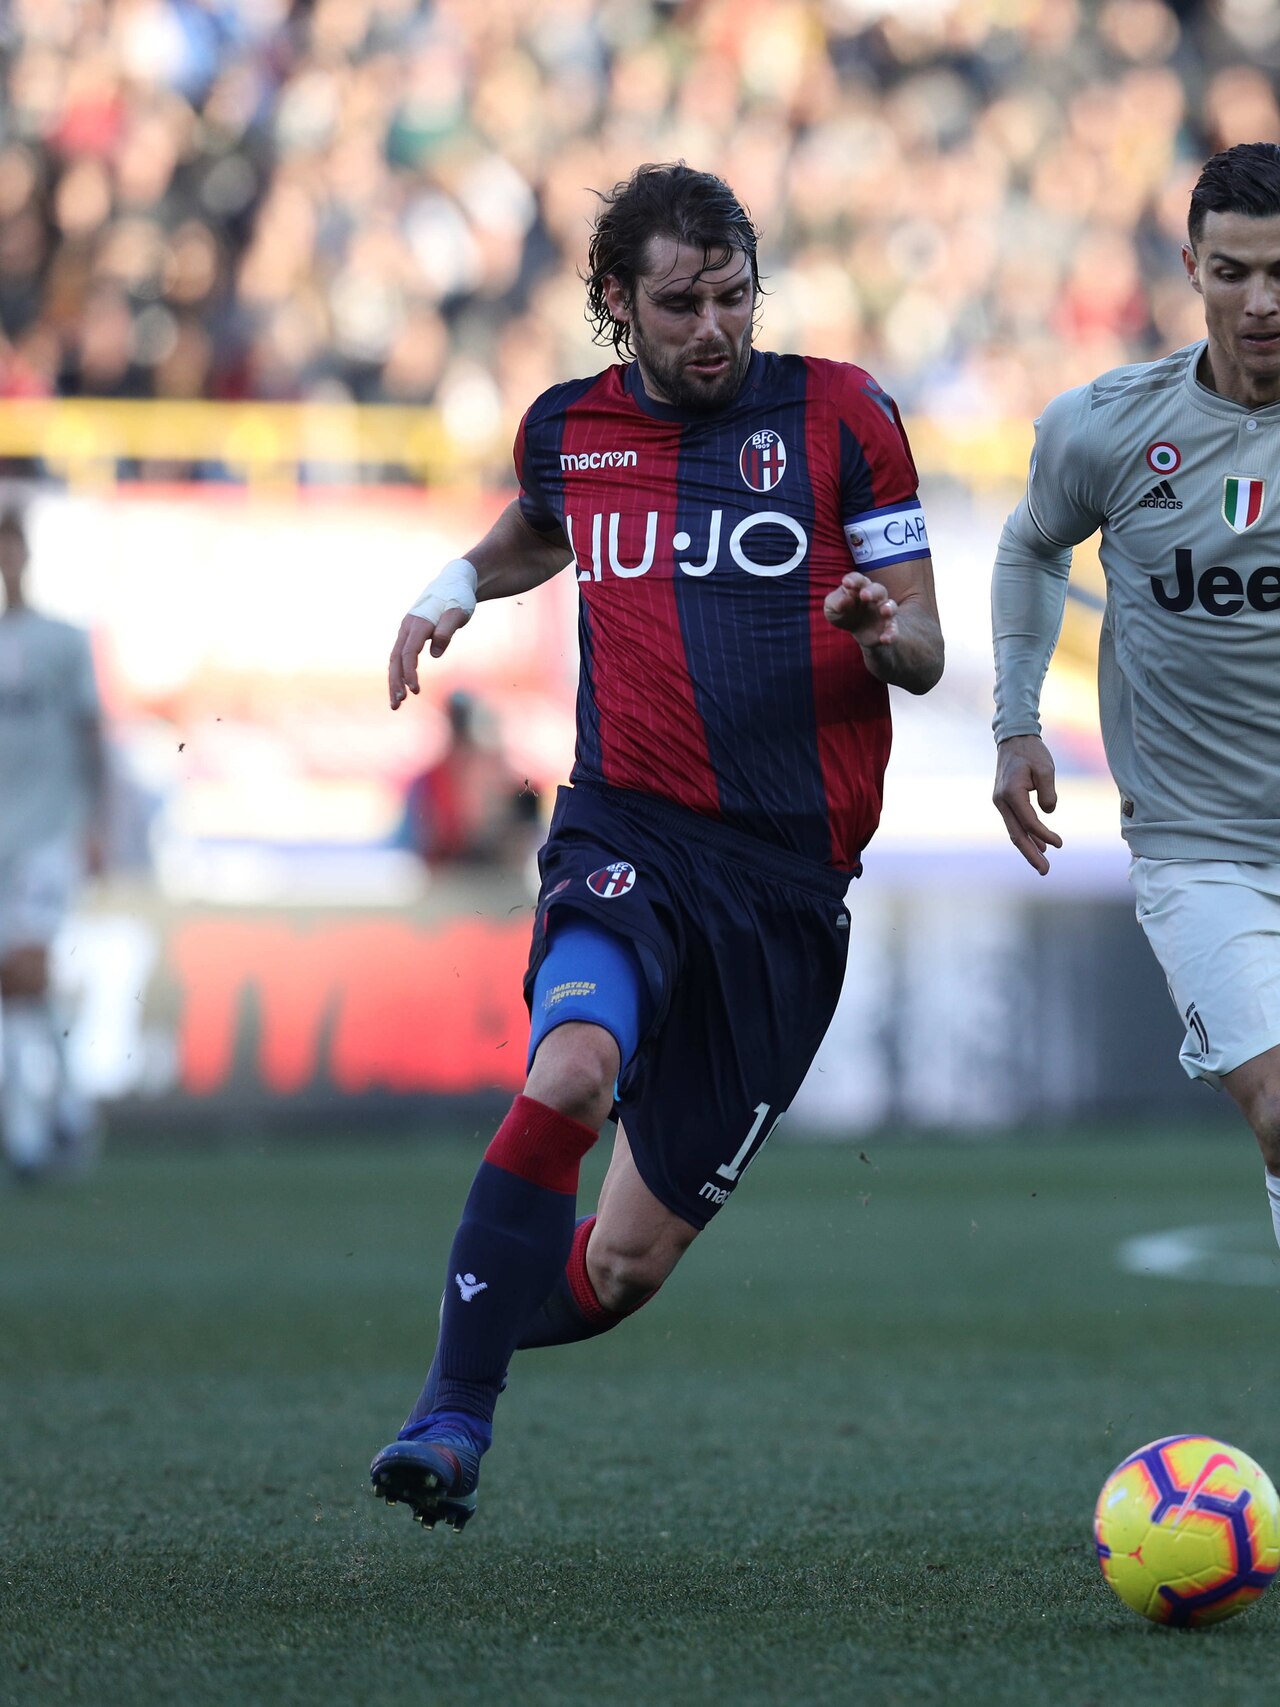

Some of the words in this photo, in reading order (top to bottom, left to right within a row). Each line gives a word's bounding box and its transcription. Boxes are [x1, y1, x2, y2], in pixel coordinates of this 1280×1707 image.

[752, 432, 774, 445] BFC
[560, 451, 637, 471] macron
[1138, 497, 1183, 510] adidas
